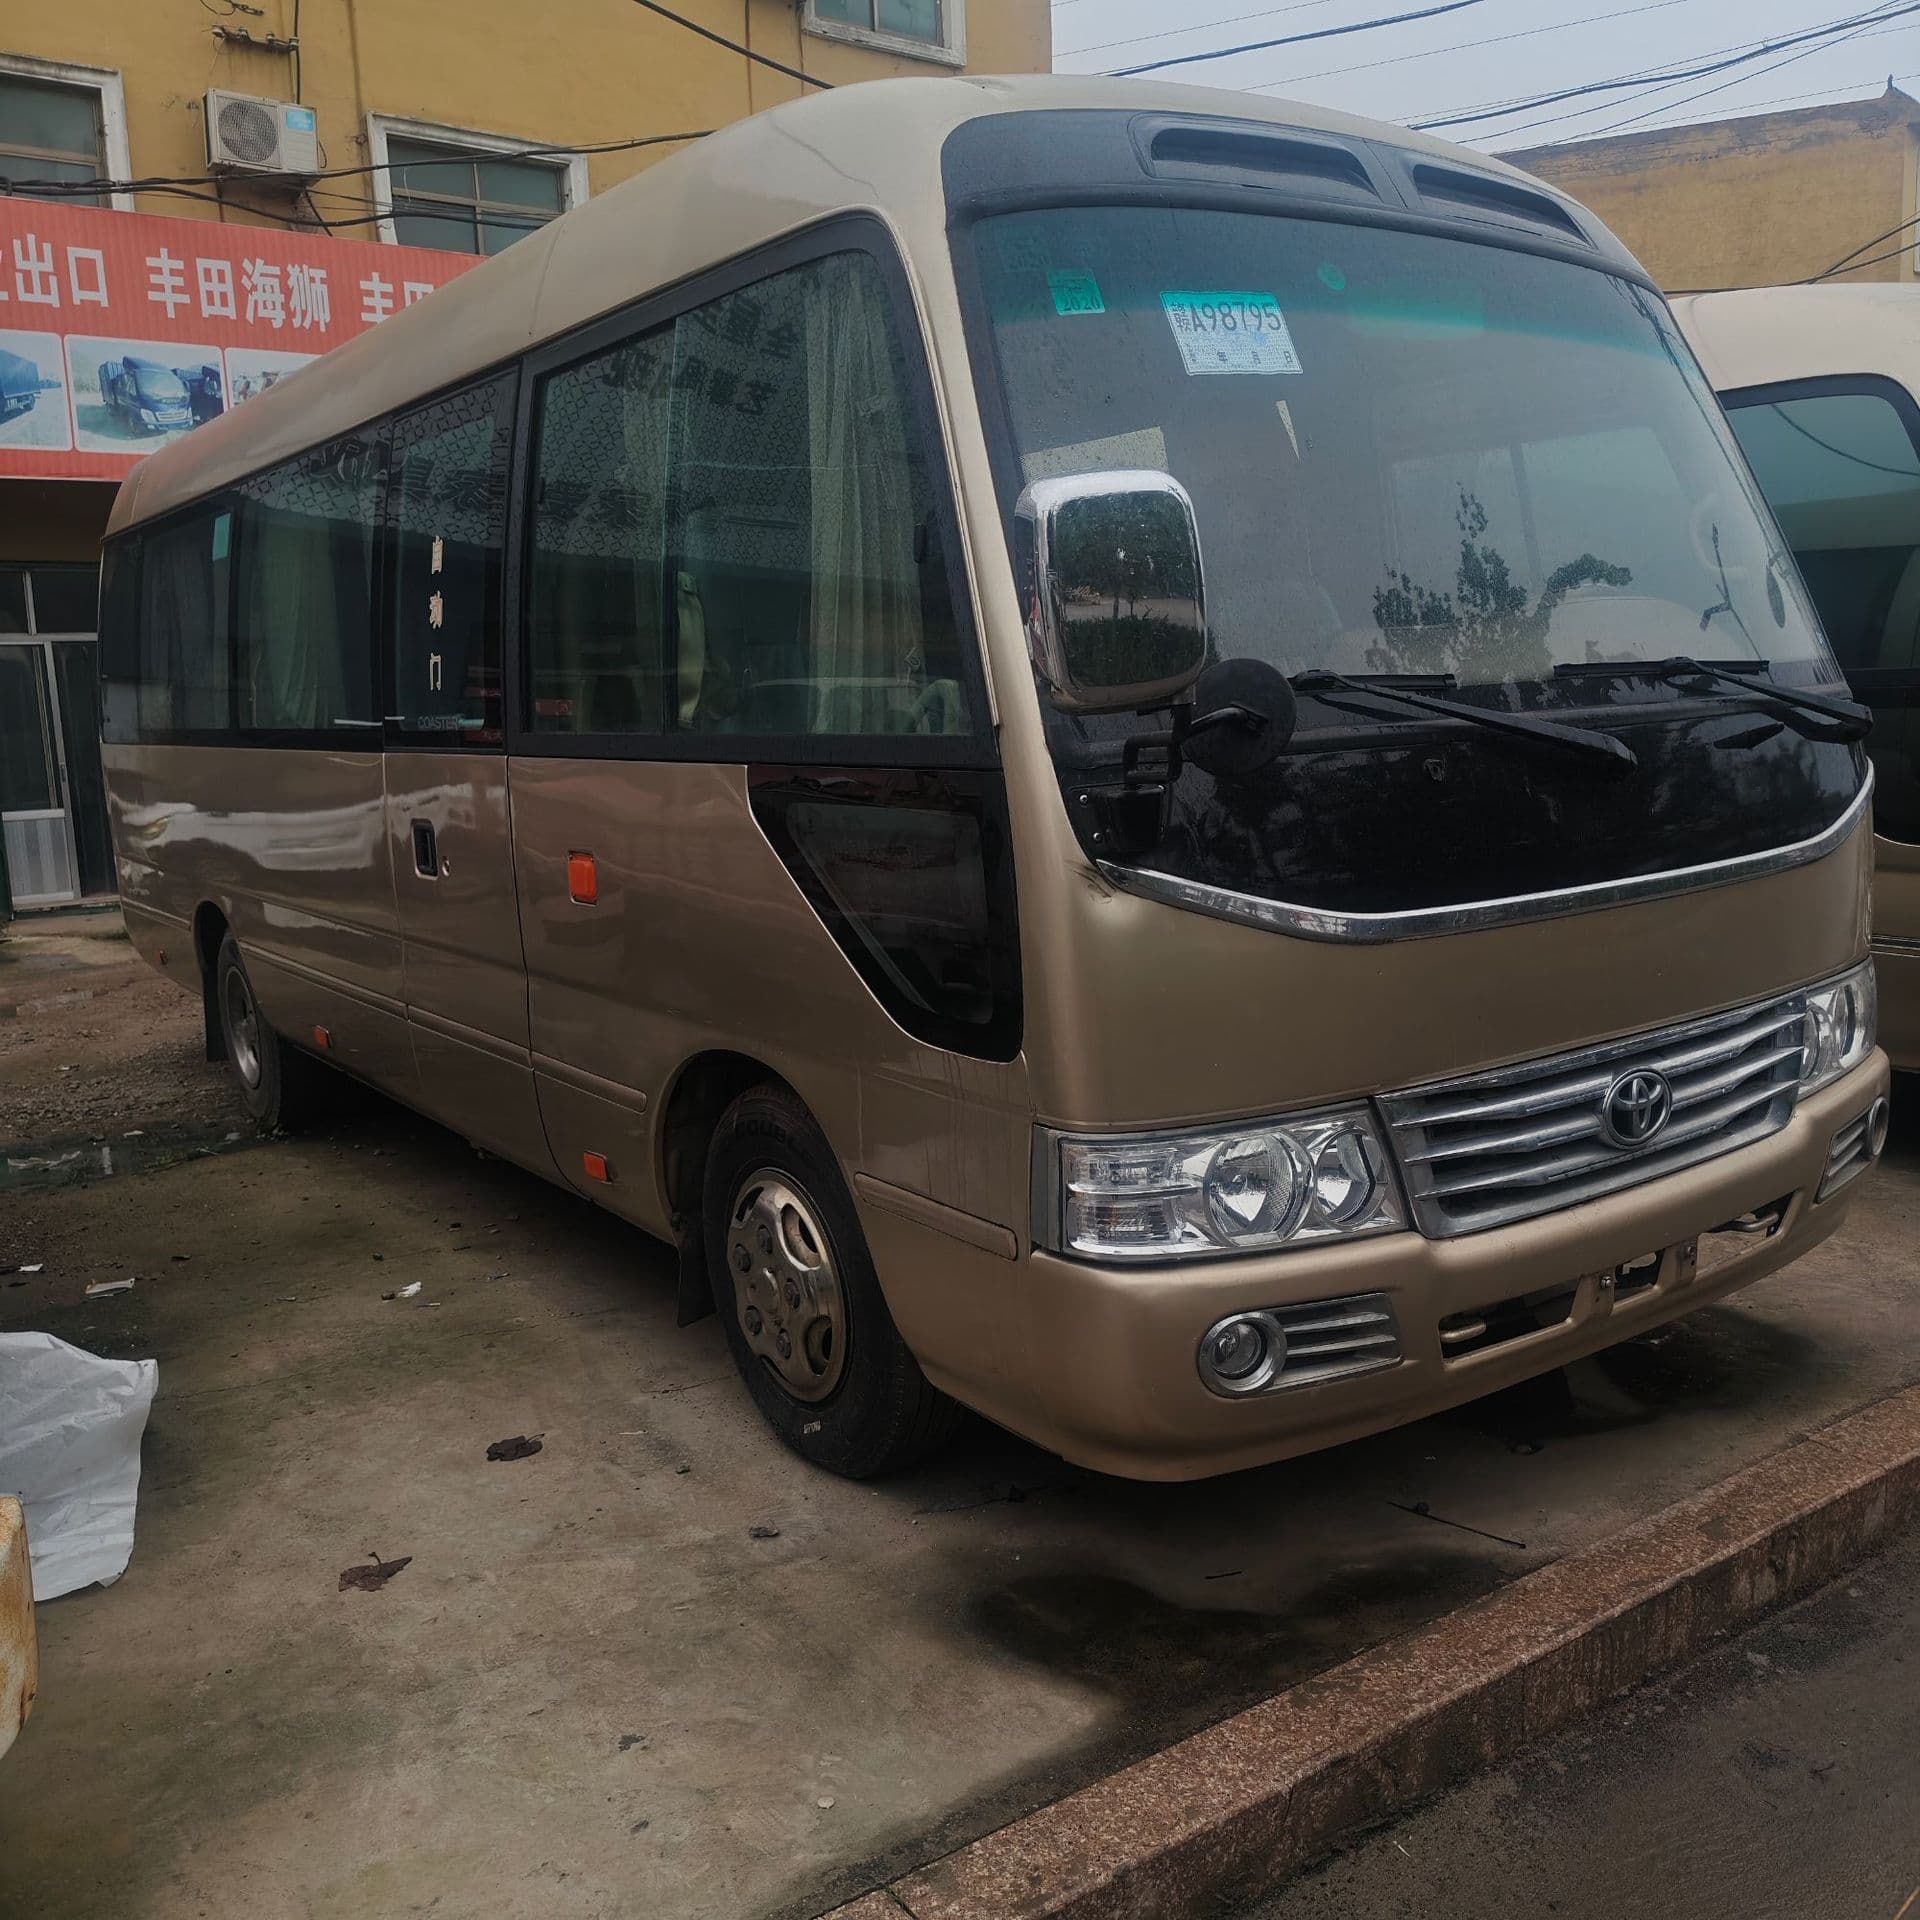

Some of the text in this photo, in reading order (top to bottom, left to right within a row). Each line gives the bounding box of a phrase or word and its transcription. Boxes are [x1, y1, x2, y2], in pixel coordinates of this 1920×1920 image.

[145, 246, 331, 333] 丰田海狮
[359, 271, 435, 323] 丰
[1063, 296, 1101, 311] 2020
[417, 716, 458, 731] COASTER
